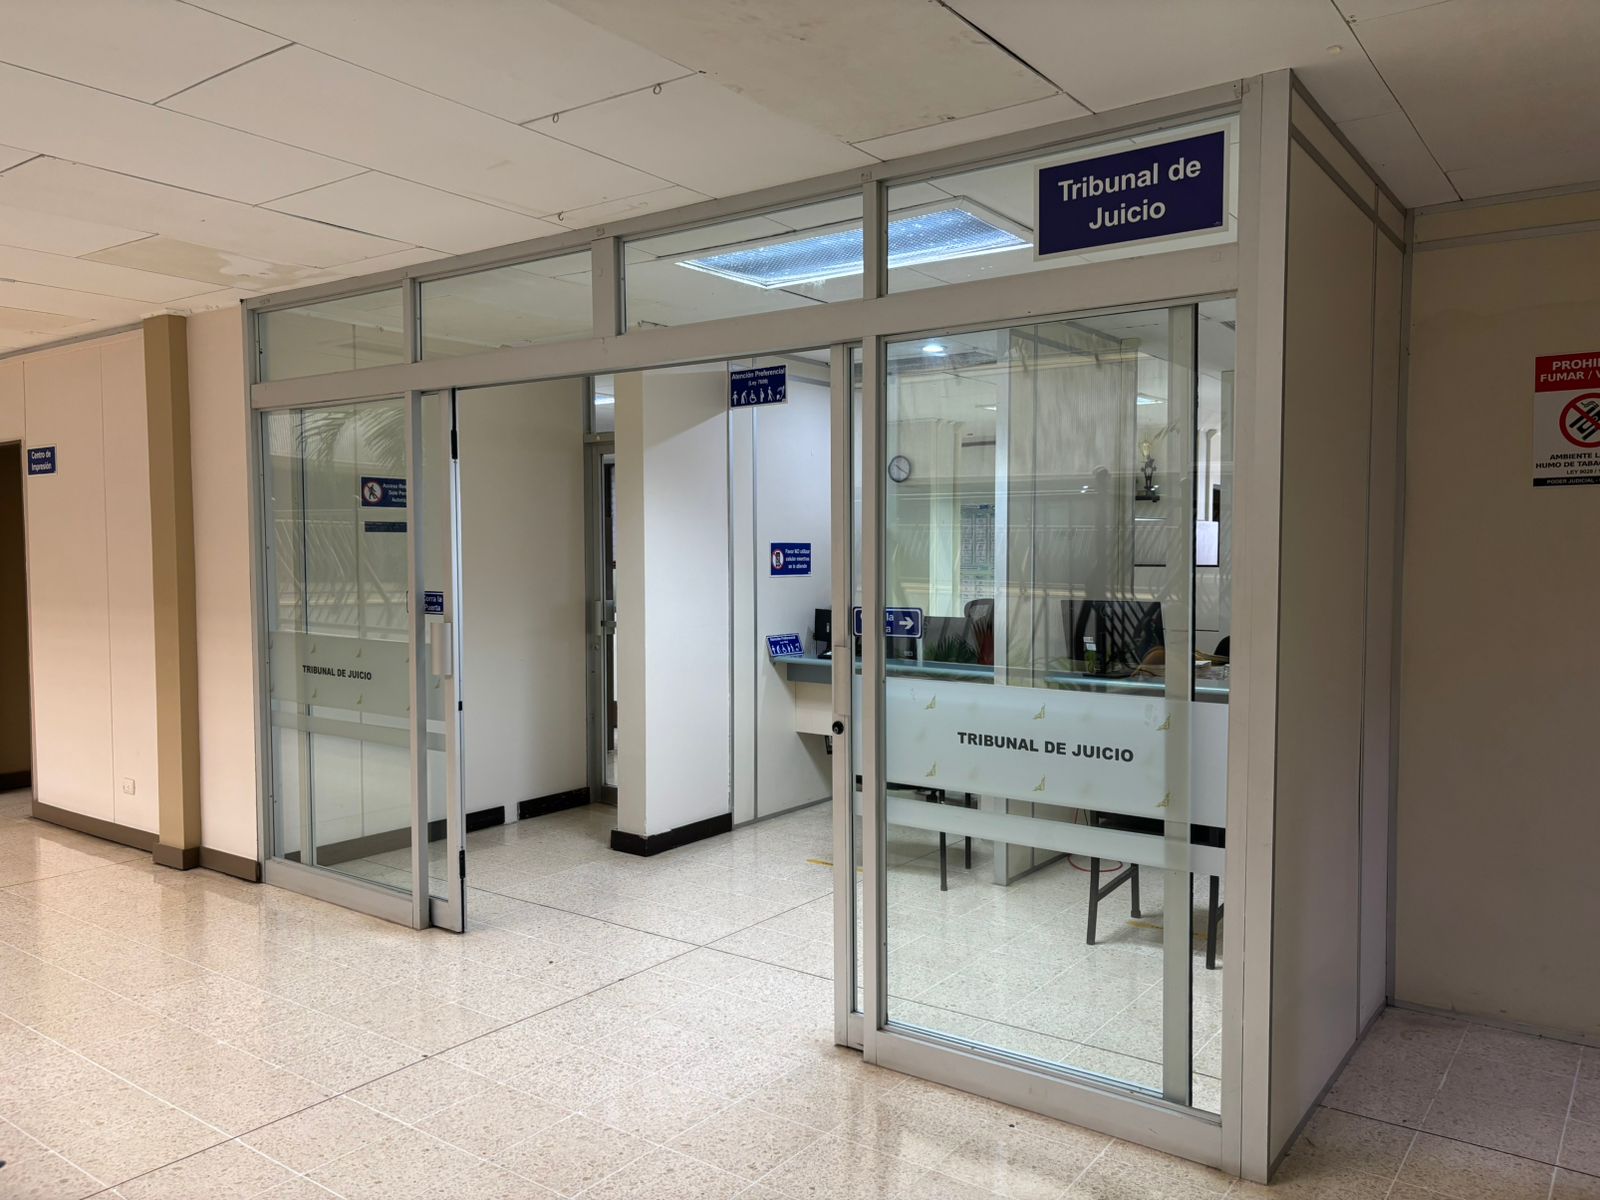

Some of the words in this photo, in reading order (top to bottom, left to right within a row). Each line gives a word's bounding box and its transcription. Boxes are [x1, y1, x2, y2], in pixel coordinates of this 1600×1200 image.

[1058, 162, 1159, 202] Tribunal
[1168, 157, 1201, 182] de
[1088, 199, 1166, 230] Juicio
[731, 371, 754, 380] Atención
[754, 367, 785, 377] Preferencial
[1540, 371, 1584, 382] FUMAR
[31, 451, 46, 459] Centro
[45, 450, 51, 458] de
[31, 462, 52, 472] Impresión
[302, 664, 336, 677] TRIBUNAL
[337, 668, 347, 678] DE
[347, 670, 372, 680] JUICIO
[957, 731, 1039, 752] TRIBUNAL
[1044, 741, 1067, 755] DE
[1071, 744, 1134, 763] JUICIO
